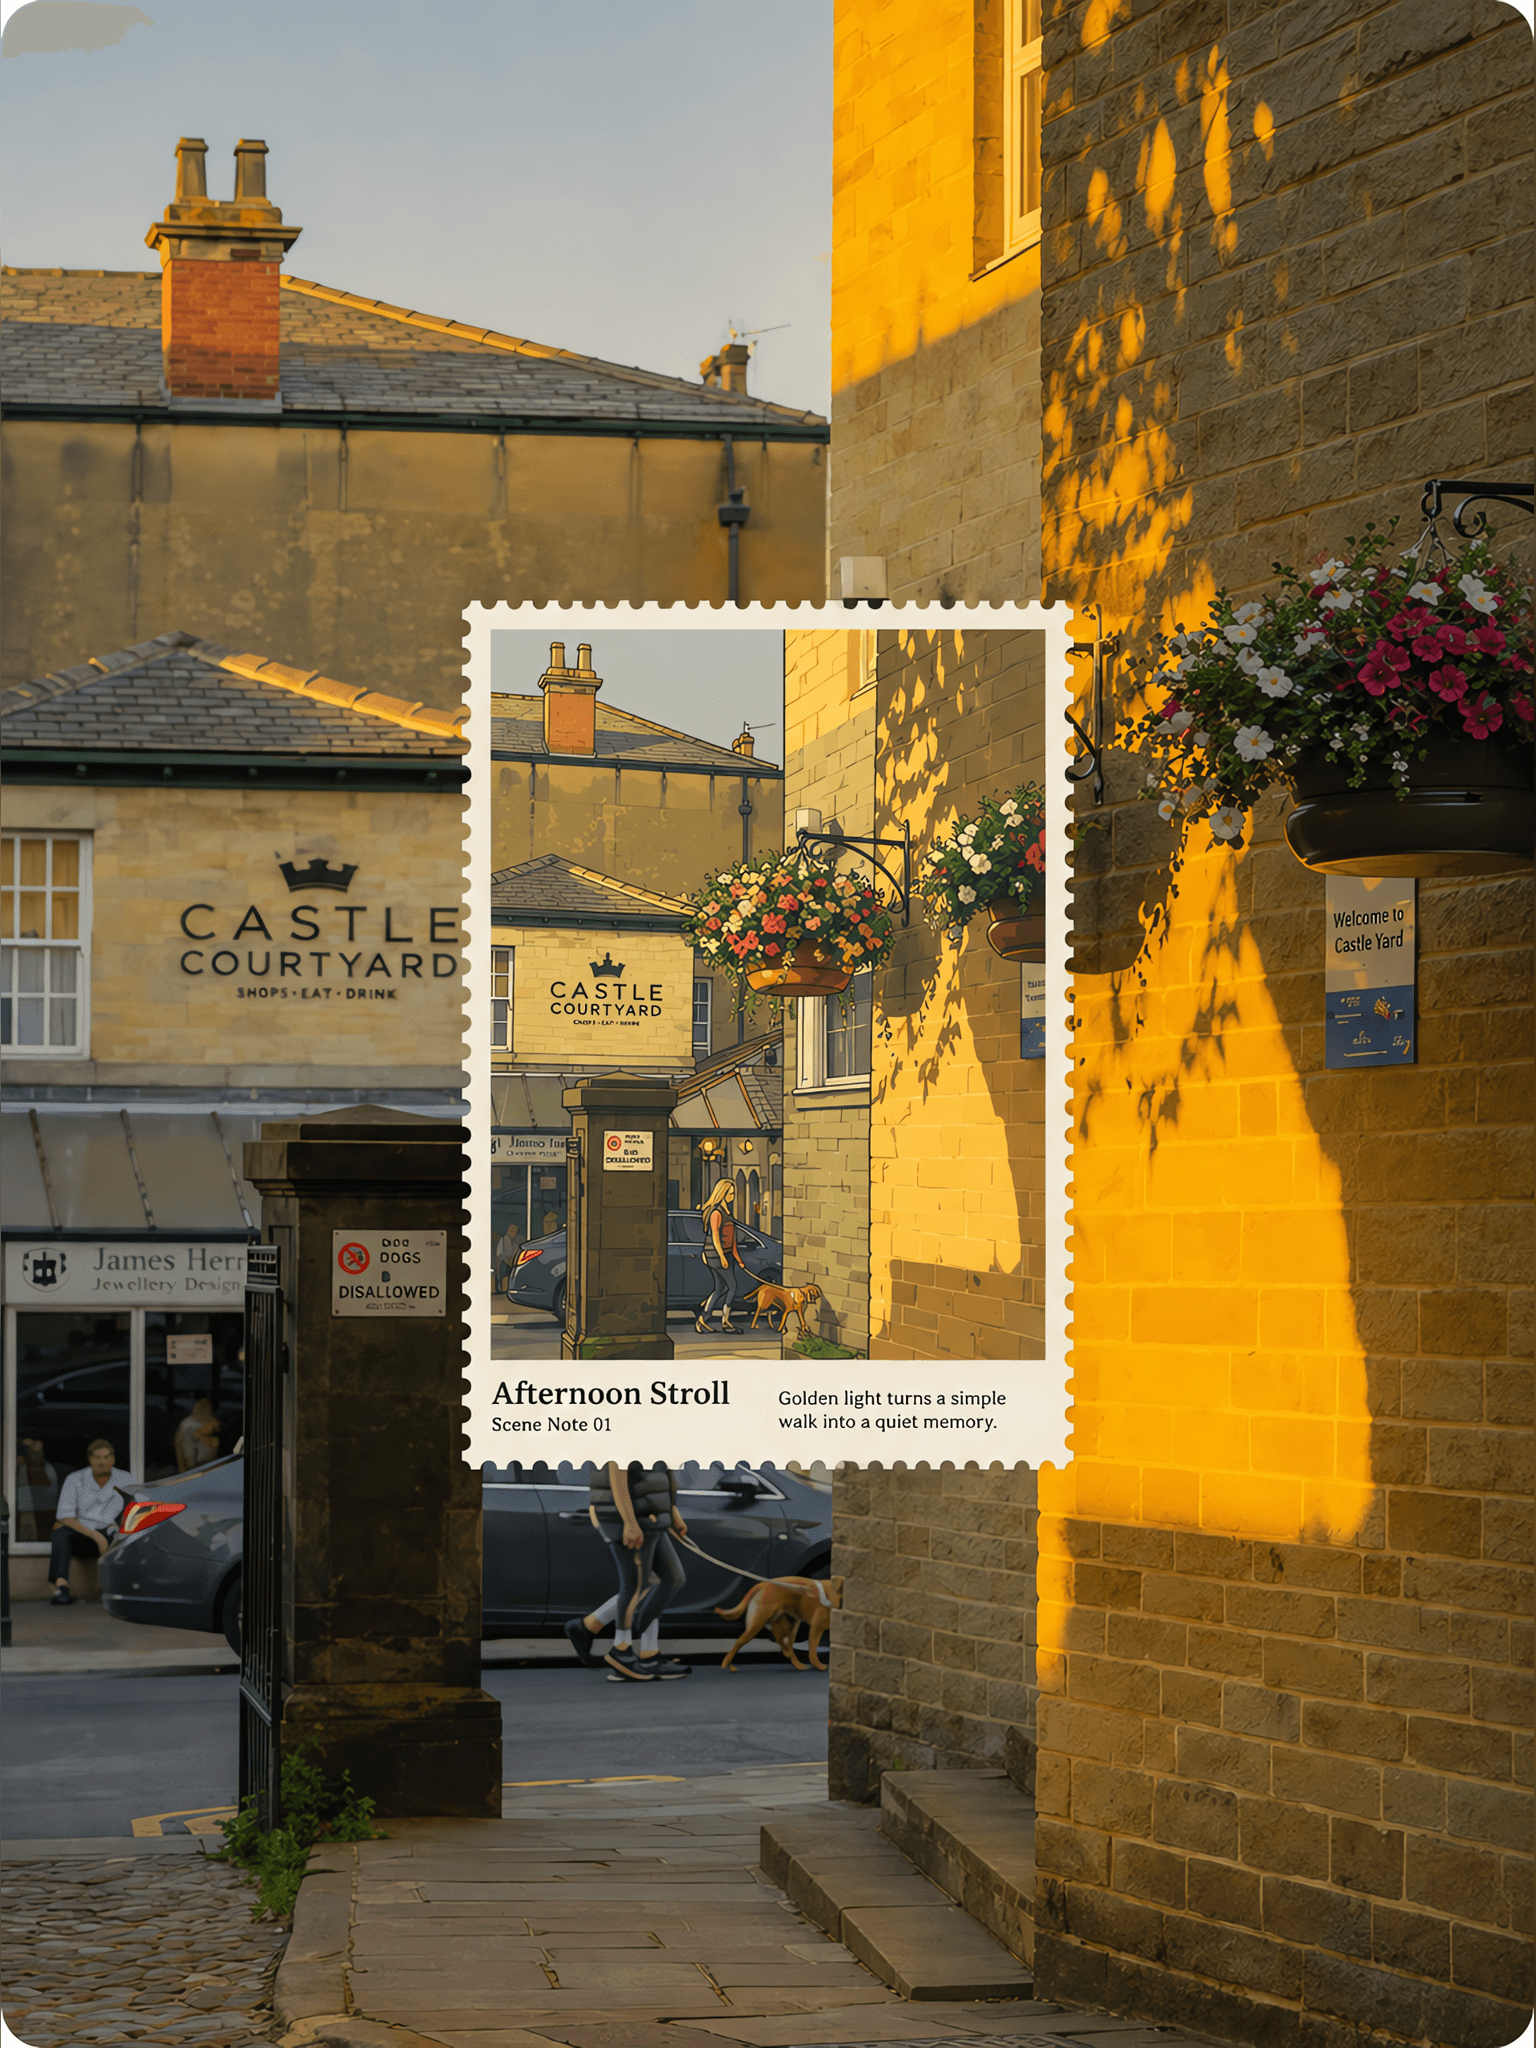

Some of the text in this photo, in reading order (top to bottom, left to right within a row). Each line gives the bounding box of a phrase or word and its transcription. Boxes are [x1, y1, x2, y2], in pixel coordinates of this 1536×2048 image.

[180, 903, 459, 943] CASTLE
[1334, 908, 1404, 928] Welcome to
[1335, 929, 1404, 954] Castle Yard
[180, 950, 458, 978] COURTYARD
[237, 987, 397, 1000] SHOPS EAT DRINK
[93, 1247, 175, 1271] James
[380, 1251, 421, 1264] DOGS
[90, 1277, 177, 1295] Jewellery
[339, 1285, 440, 1299] DISALLOWED
